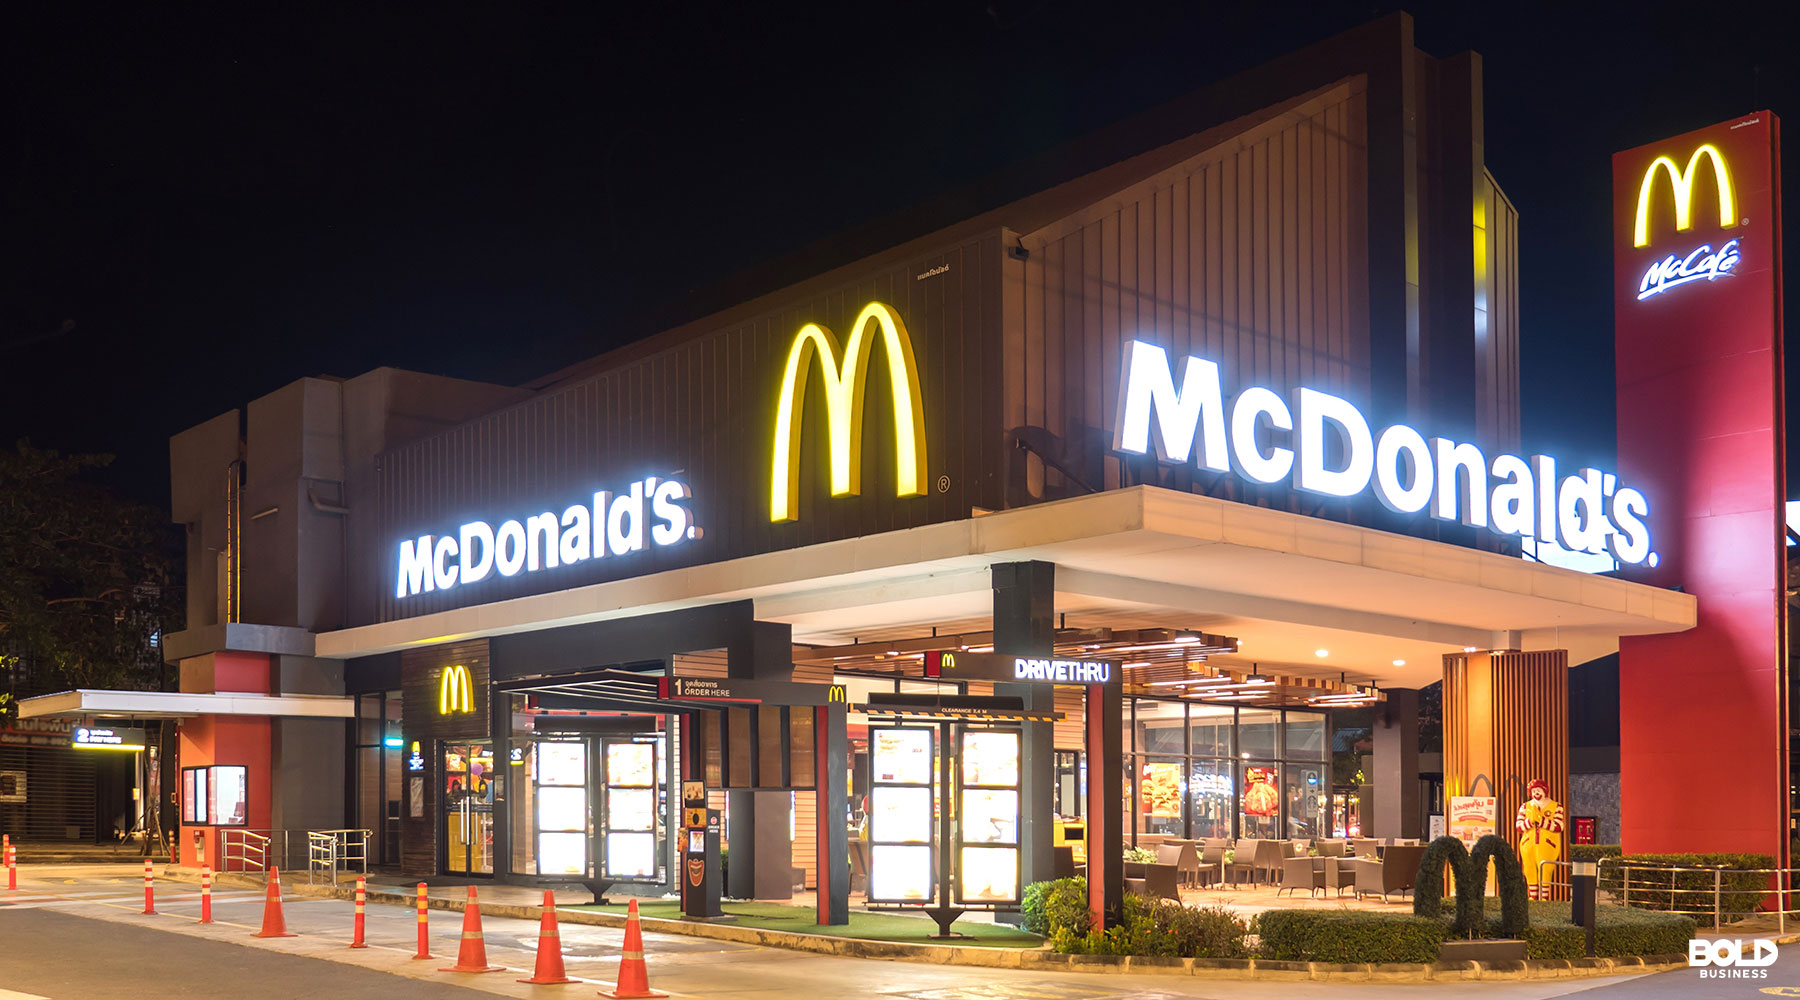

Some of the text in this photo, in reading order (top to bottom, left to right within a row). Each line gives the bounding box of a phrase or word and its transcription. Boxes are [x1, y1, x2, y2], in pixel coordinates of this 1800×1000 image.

[1637, 237, 1742, 300] McCafé
[674, 679, 682, 696] 1
[684, 688, 730, 697] ORDER HERE
[75, 728, 90, 743] 2
